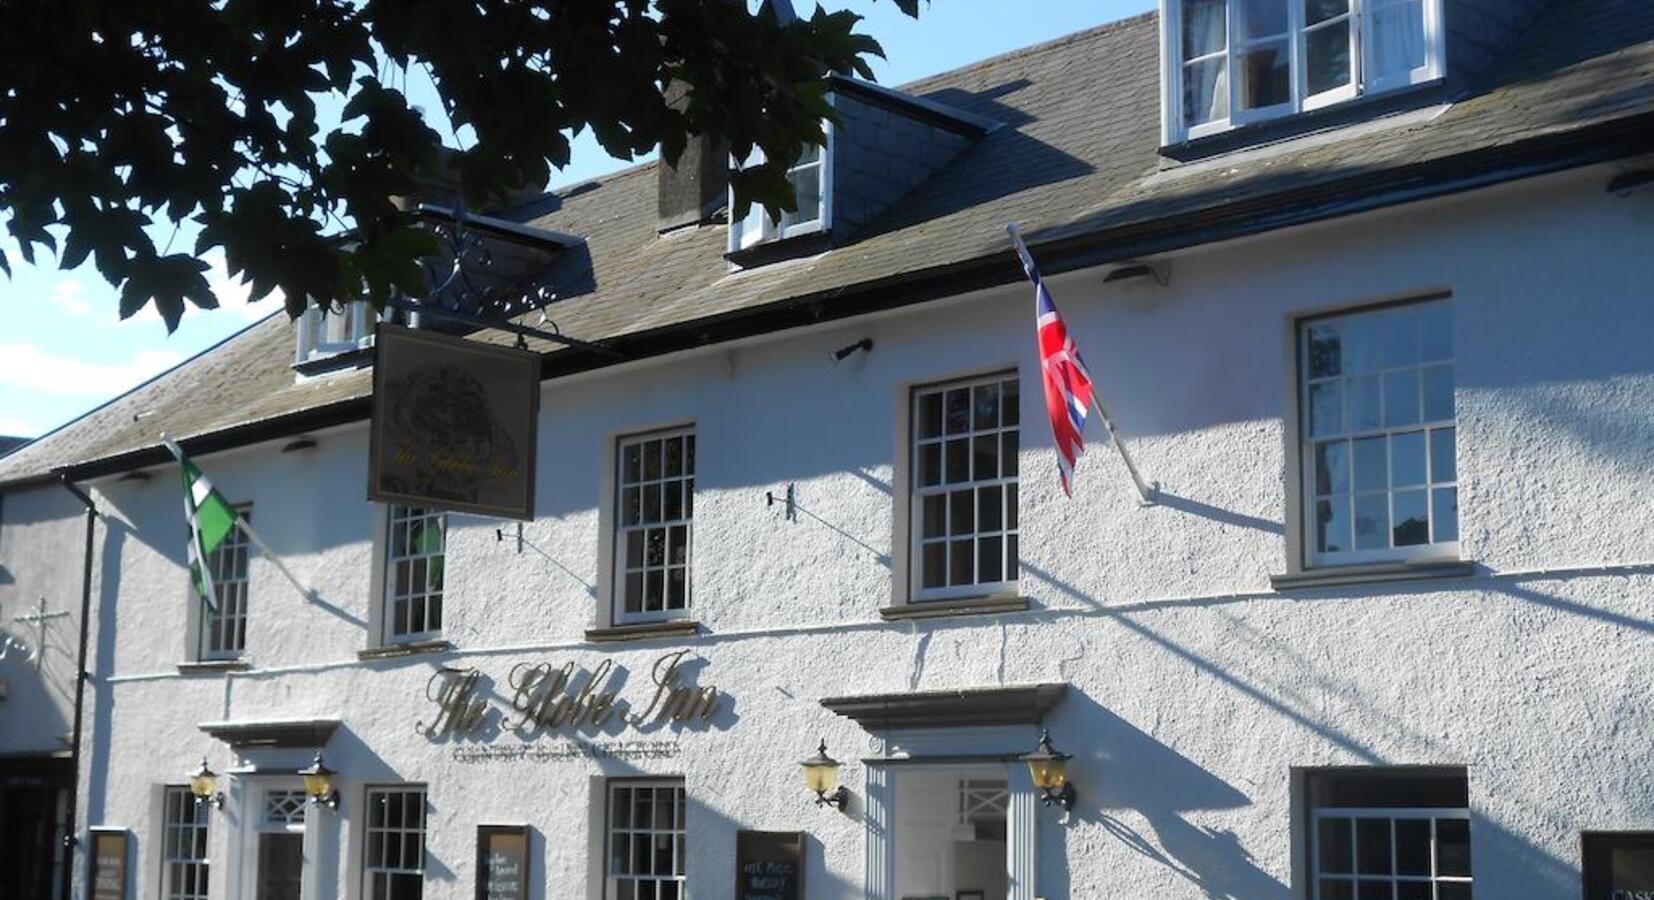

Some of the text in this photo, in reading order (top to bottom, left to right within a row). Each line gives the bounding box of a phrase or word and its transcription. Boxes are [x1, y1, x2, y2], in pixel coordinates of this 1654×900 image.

[416, 649, 719, 738] The Globe Inn
